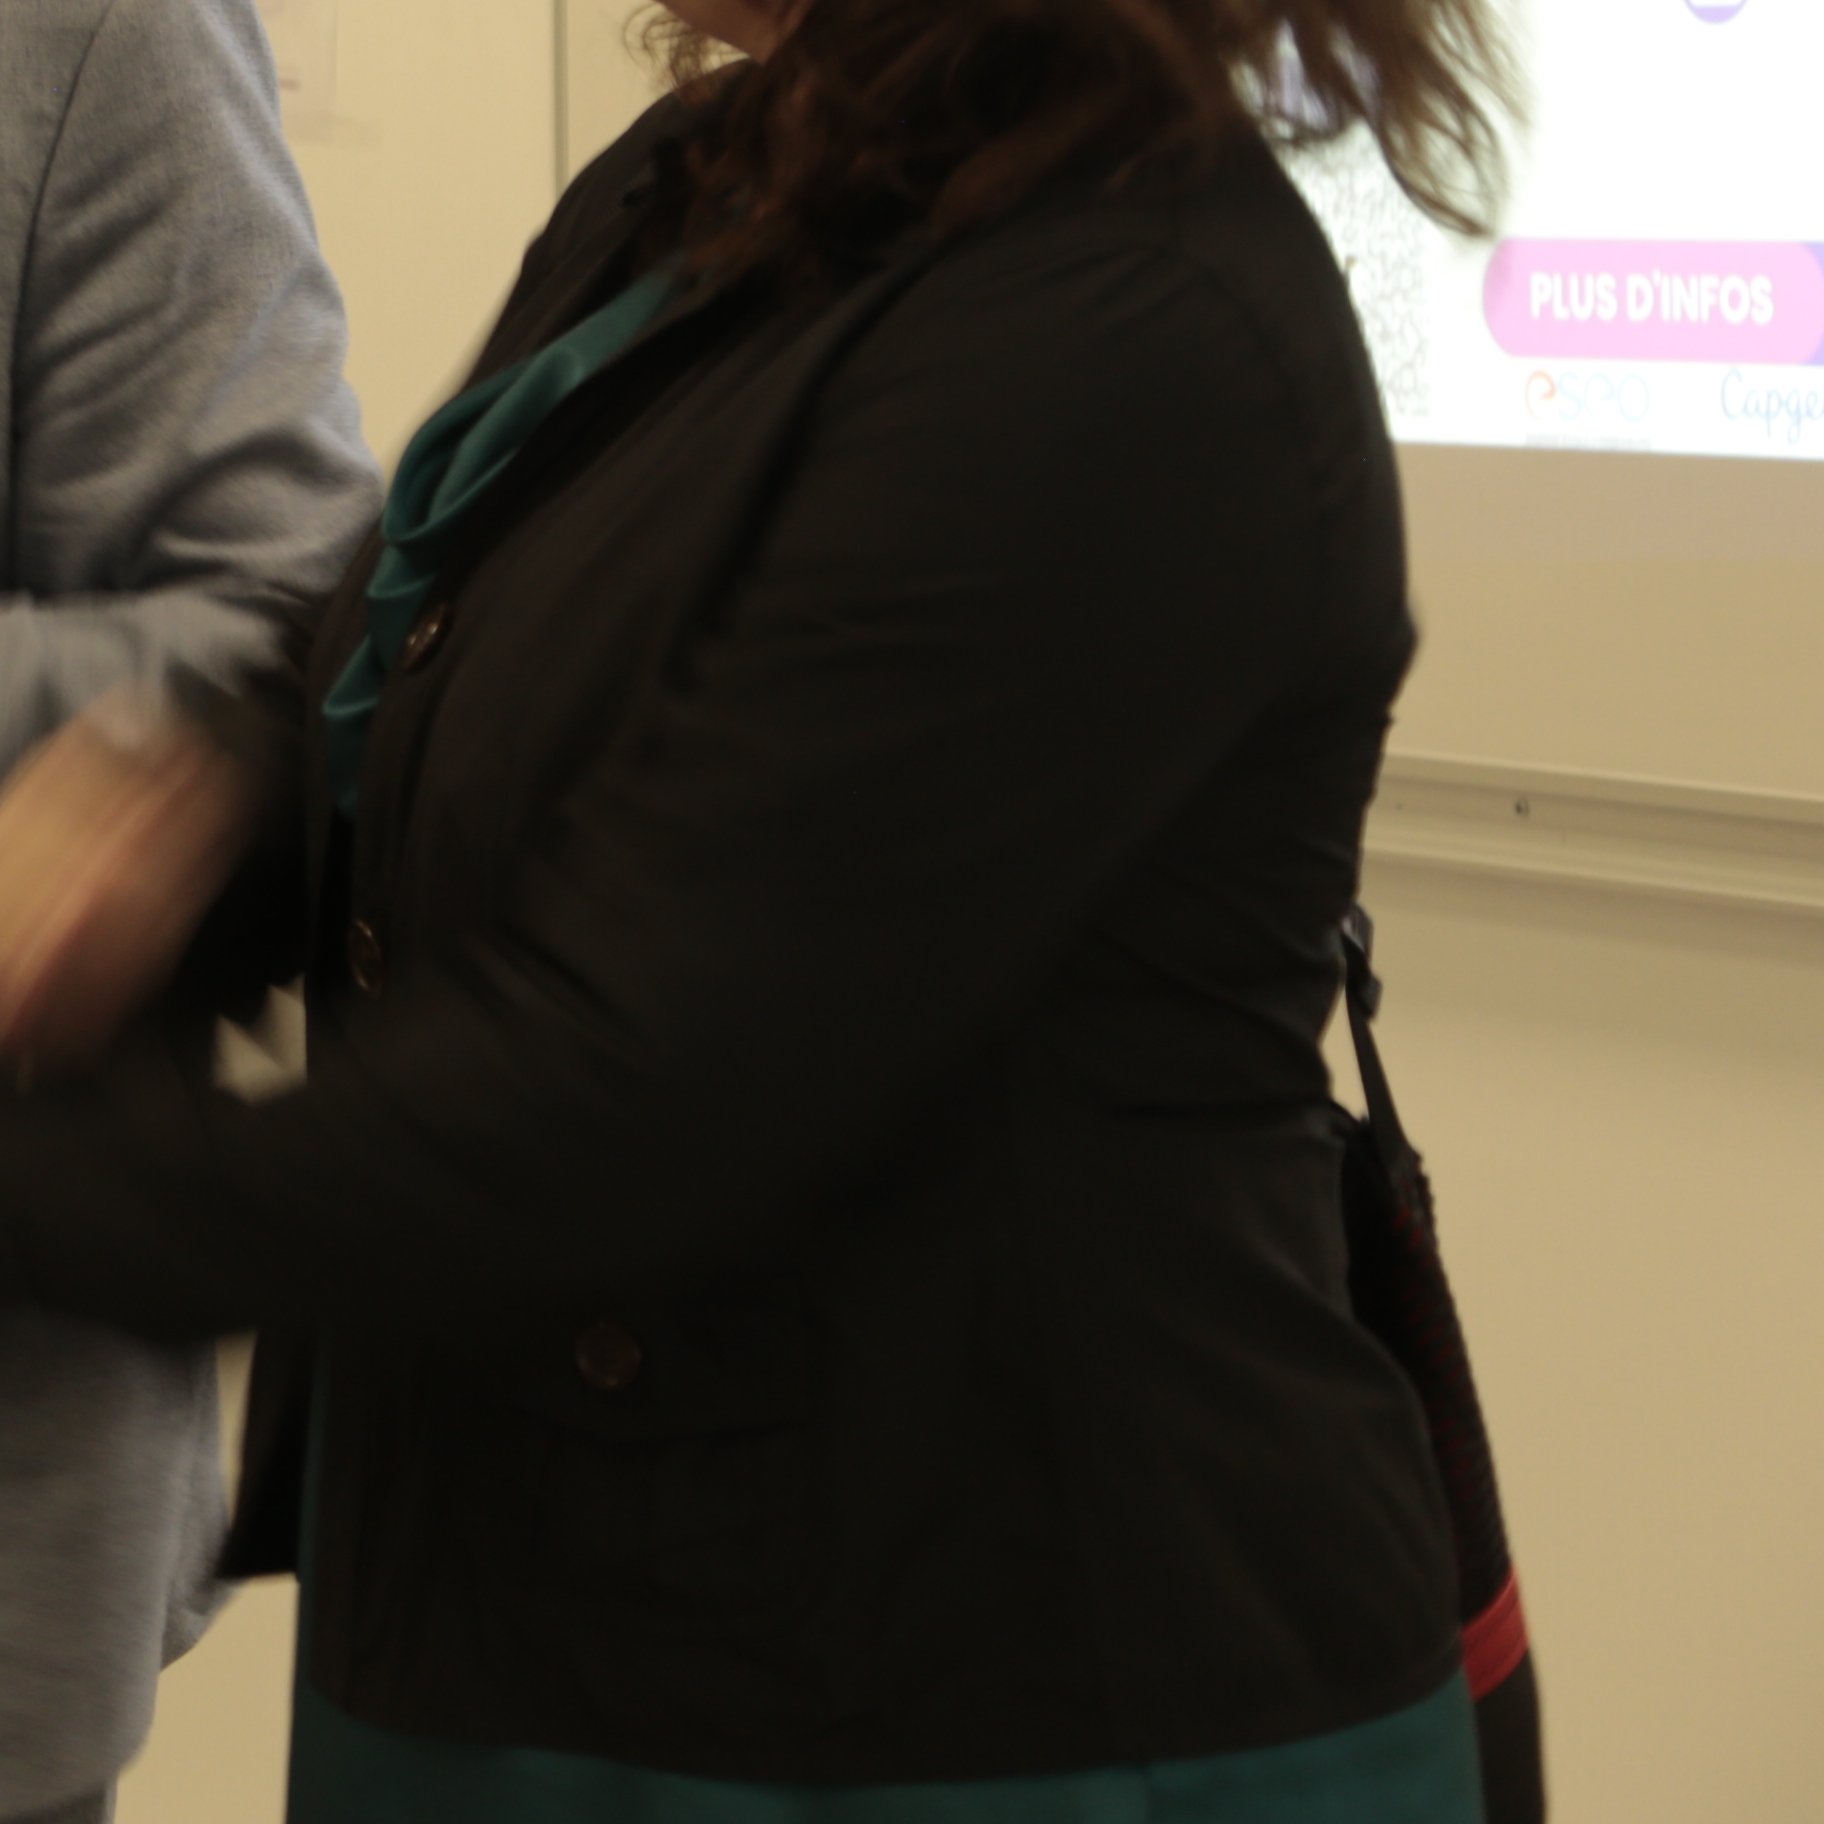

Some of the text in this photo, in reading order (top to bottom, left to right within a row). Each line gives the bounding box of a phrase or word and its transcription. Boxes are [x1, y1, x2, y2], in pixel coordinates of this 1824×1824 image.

[1529, 267, 1775, 325] PLUS D'INFOS
[1719, 366, 1824, 446] Capge
